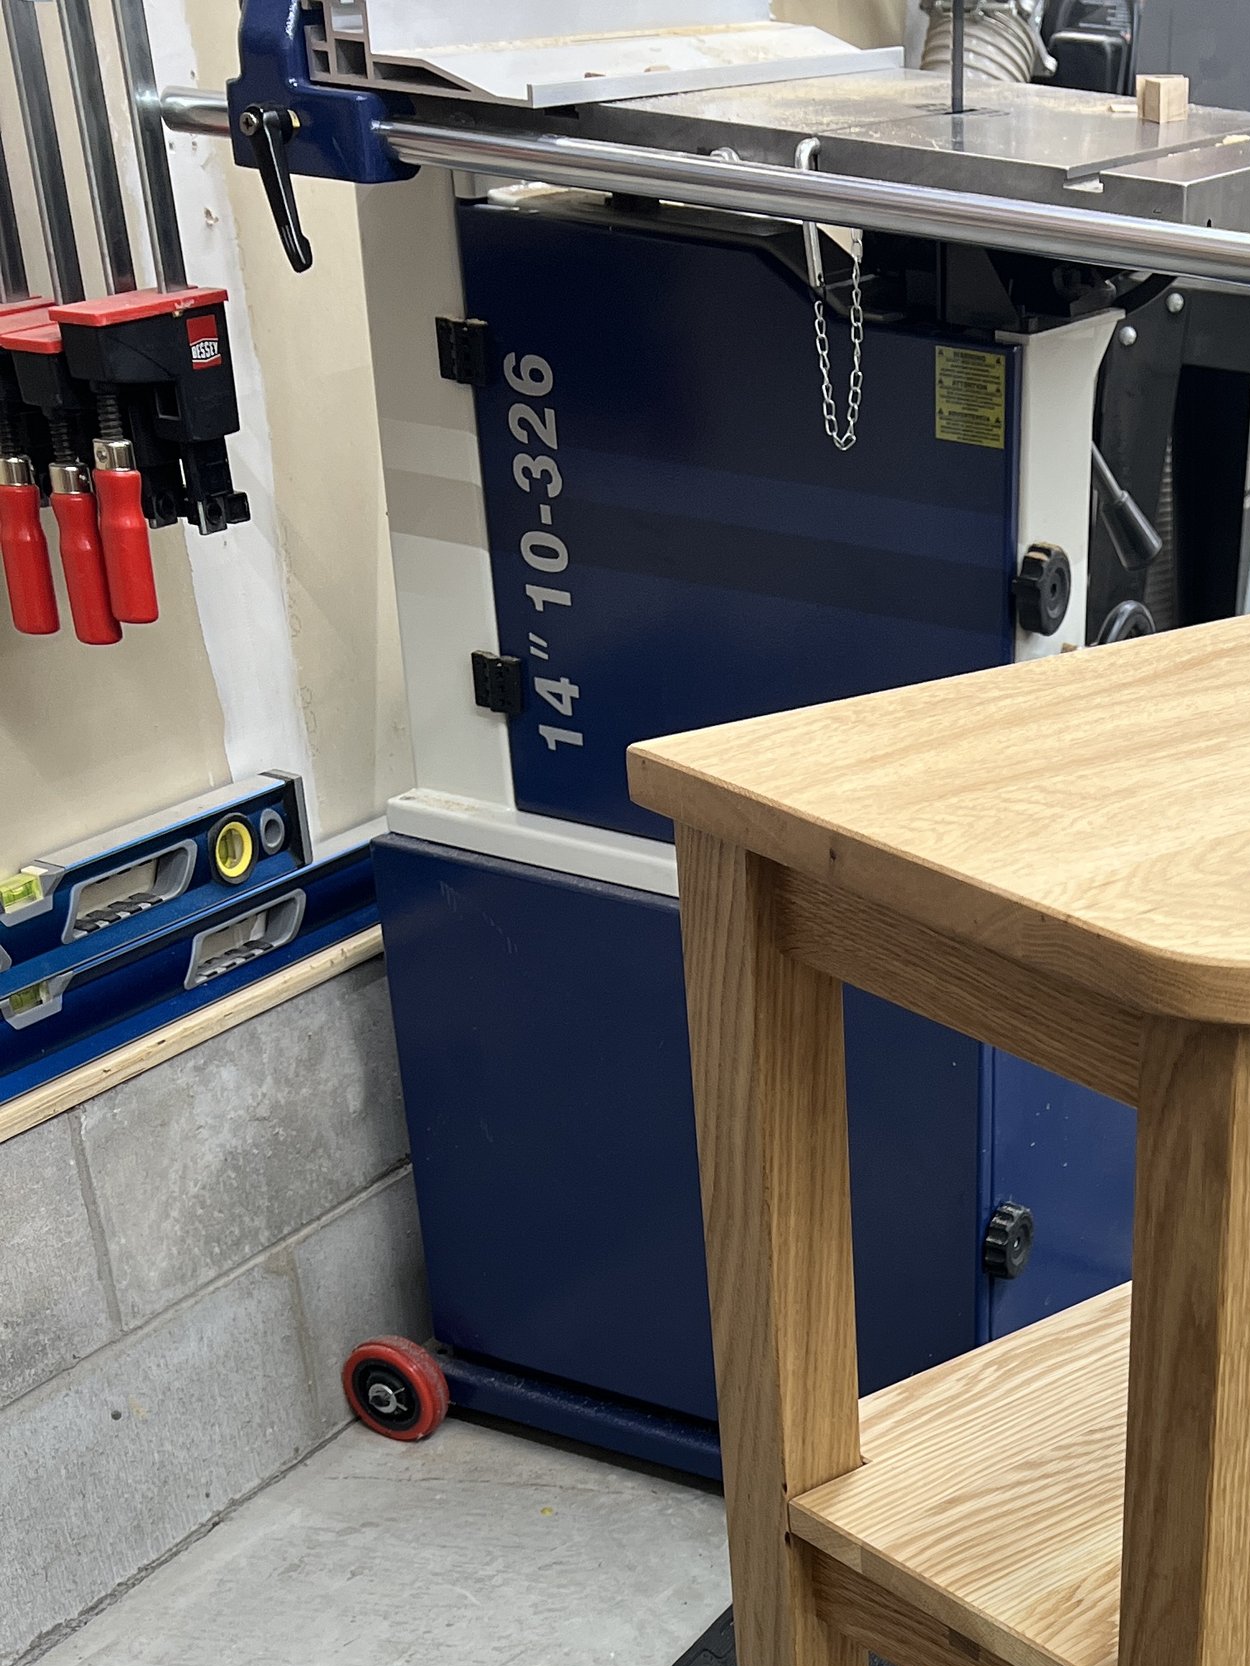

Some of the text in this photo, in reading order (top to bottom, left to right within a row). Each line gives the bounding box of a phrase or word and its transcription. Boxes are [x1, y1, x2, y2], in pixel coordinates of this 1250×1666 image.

[191, 341, 218, 359] BESSEY
[953, 351, 986, 361] WARNING
[952, 380, 988, 391] ATTENTION
[503, 352, 583, 750] 14" 10-326
